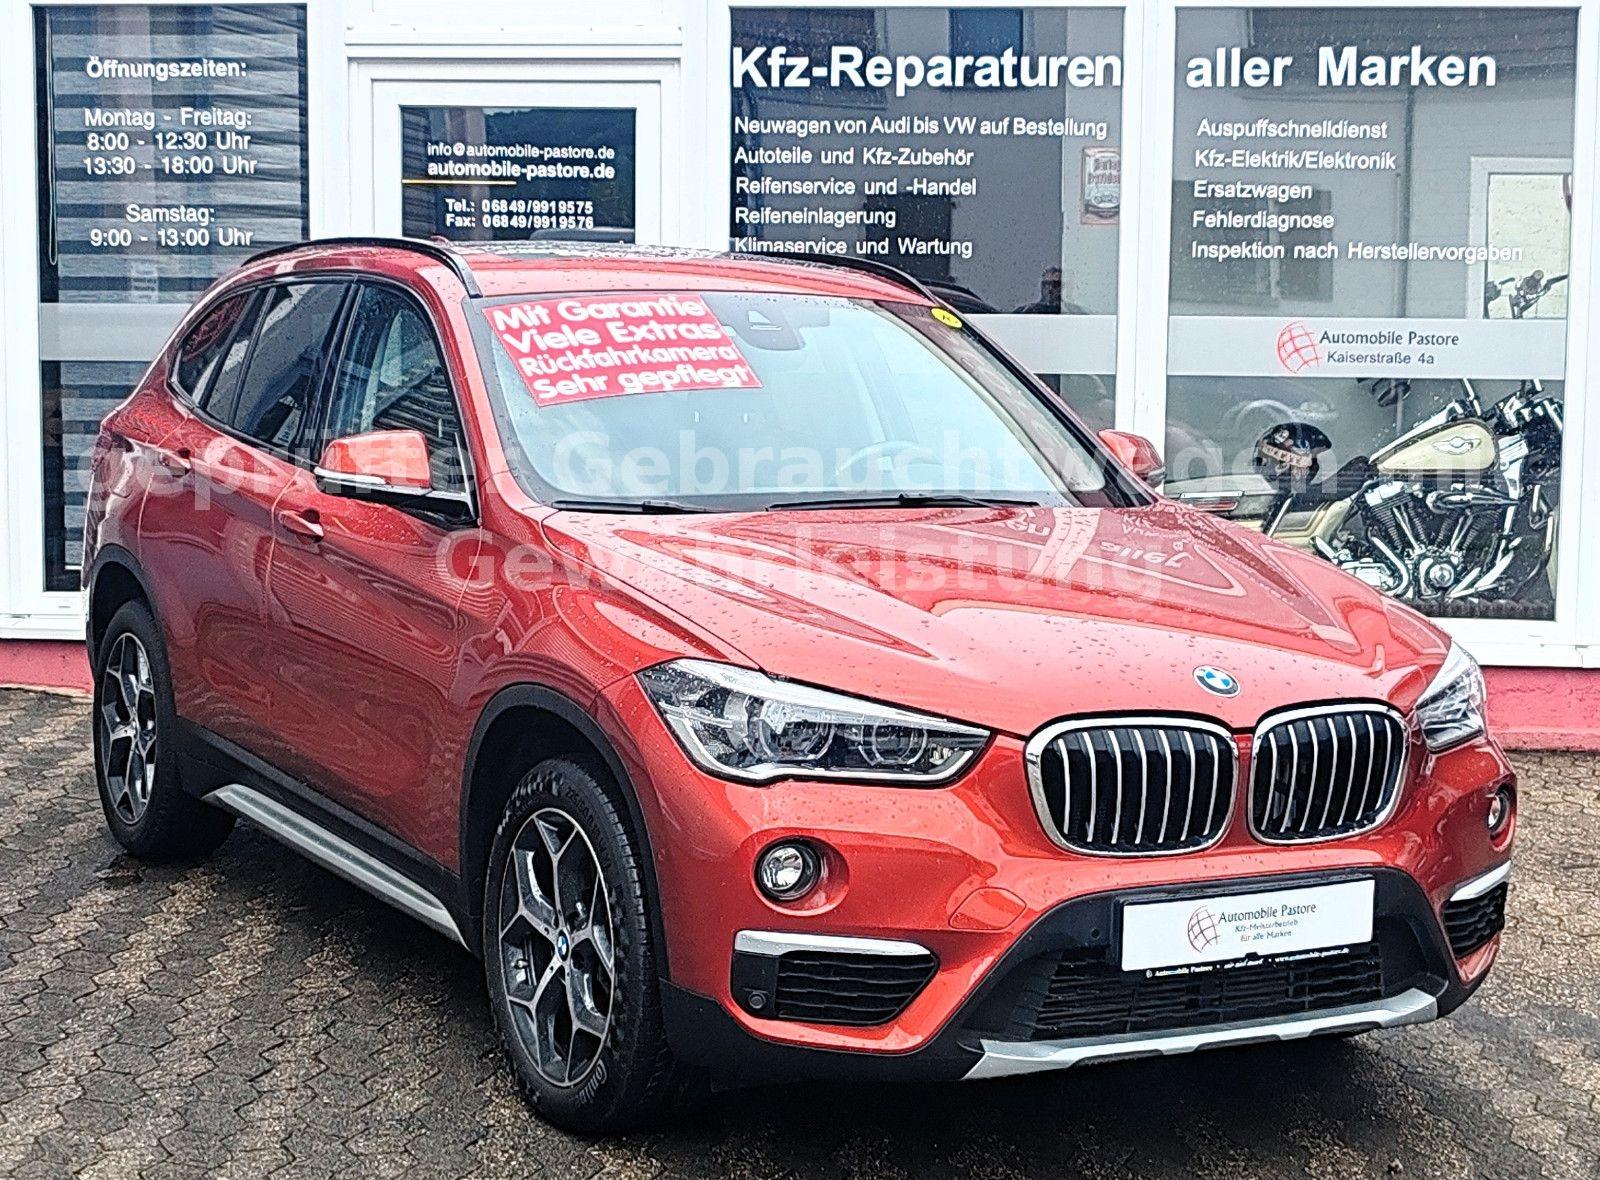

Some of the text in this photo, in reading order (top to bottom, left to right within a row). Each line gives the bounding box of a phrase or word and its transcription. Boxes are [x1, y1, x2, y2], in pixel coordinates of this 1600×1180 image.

[86, 55, 248, 81] Öffnungszeiten:
[732, 46, 1121, 96] Kfz-Reparaturen
[1186, 45, 1497, 88] aller Marken
[84, 109, 155, 129] Montag
[180, 107, 252, 128] Freitag:
[734, 116, 1108, 139] Neuwagen von Audi bis VW auf Bestellung
[1197, 119, 1388, 140] Auspuffschnelldienst
[86, 133, 129, 151] 8:00
[155, 132, 207, 150] 12:30
[216, 132, 251, 150] Uhr
[427, 142, 615, 160] info@automobile-pastore.de
[83, 157, 136, 175] 13:30
[161, 156, 213, 175] 18:00
[222, 155, 257, 174] Uhr
[734, 146, 975, 166] Autoteile und Kfz-Zubehör
[1195, 150, 1397, 170] Kfz-Elektrik/Elektronik
[427, 160, 615, 181] automobile-pastore.de
[735, 176, 976, 195] Reifenservice und -Handel
[1193, 180, 1312, 202] Ersatzwagen
[126, 204, 216, 227] Samstag:
[445, 199, 593, 215] Tel.: 06849/9919575
[735, 205, 897, 228] Reifeneinlagerung
[445, 213, 594, 229] Fax: 06849/9919576
[1192, 210, 1335, 233] Fehlerdiagnose
[90, 229, 131, 247] 9:00
[158, 229, 210, 247] 13:00
[218, 228, 253, 246] Uhr
[734, 236, 973, 258] Klimaservice und Wartung
[1191, 241, 1524, 264] Inspektion nach Herstellervorgaben
[493, 296, 707, 331] Mit Garantie
[503, 320, 722, 354] Viele Extras
[1319, 330, 1460, 347] Automobile Pastore
[518, 345, 739, 377] Rückfahrkamera
[1327, 351, 1435, 366] Kaiserstraße 4a
[532, 364, 750, 399] Sehr gepflegt
[1218, 904, 1317, 923] Automobile Pastore
